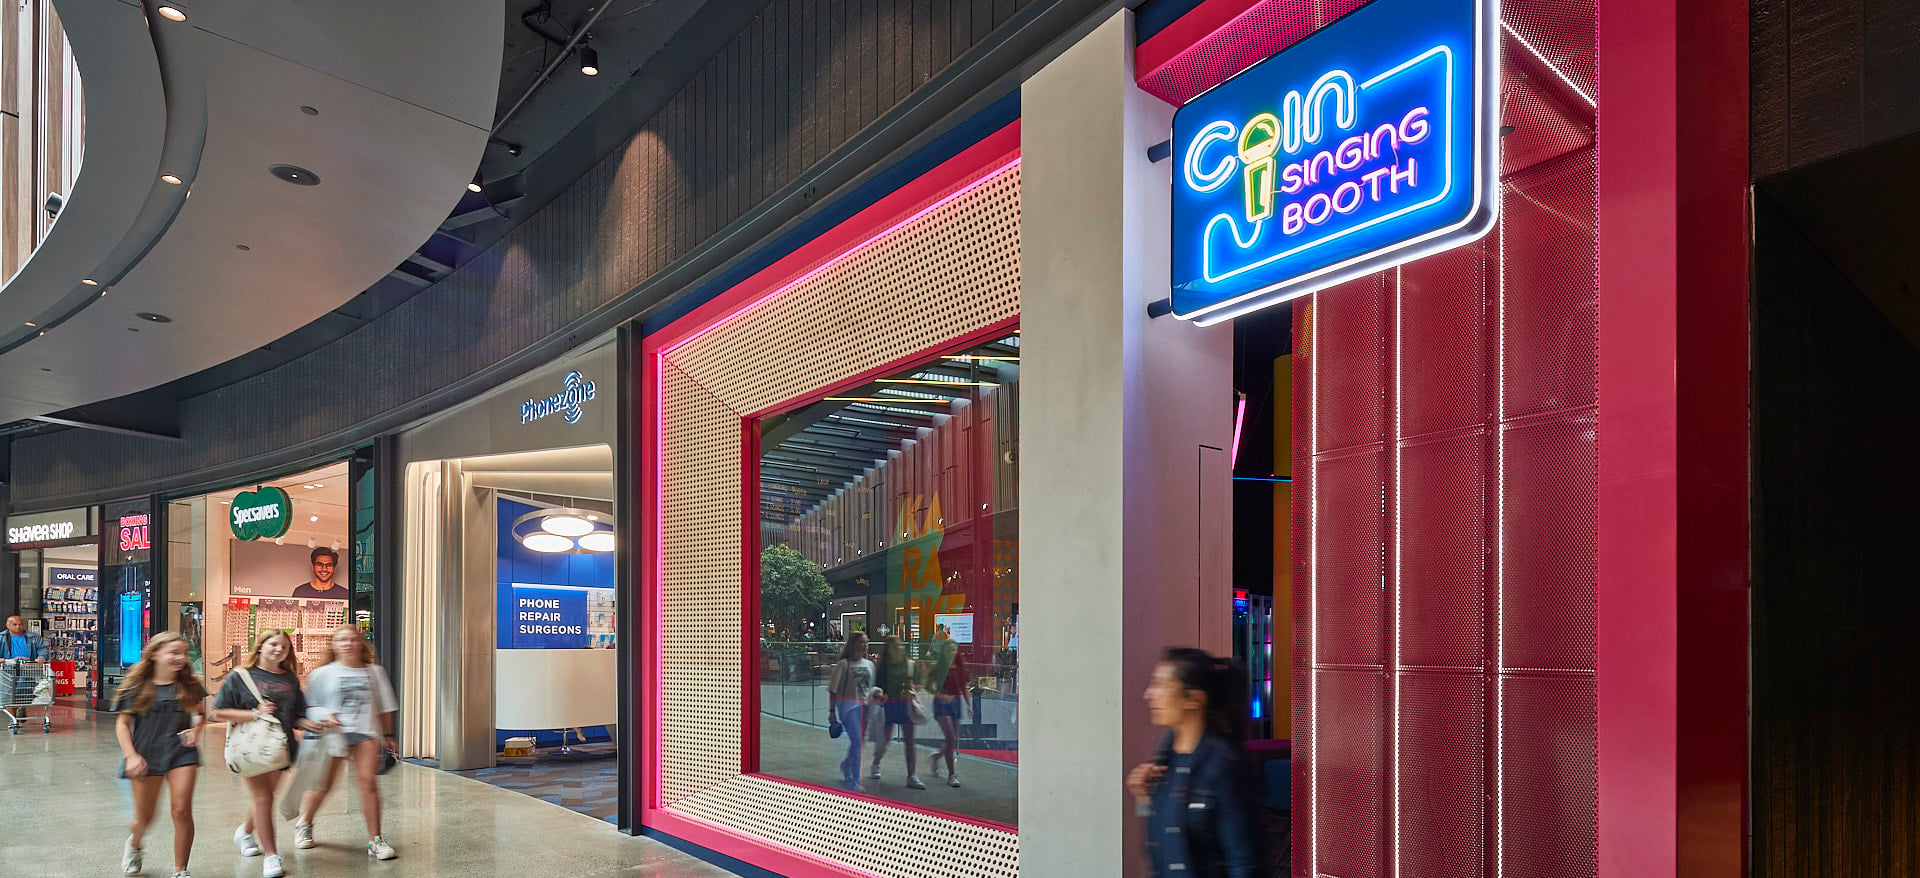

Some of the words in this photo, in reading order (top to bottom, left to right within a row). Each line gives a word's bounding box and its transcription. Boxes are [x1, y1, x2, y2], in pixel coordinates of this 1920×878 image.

[1281, 106, 1431, 194] SINGING
[1282, 158, 1418, 235] BOOTH
[233, 502, 279, 528] Specsavers
[49, 521, 74, 540] SHOP
[120, 525, 151, 551] SAL
[56, 573, 76, 581] ORAL
[233, 586, 252, 594] Men
[519, 598, 560, 609] PHONE
[519, 611, 561, 622] REPAIR
[519, 625, 582, 635] SURGEONS
